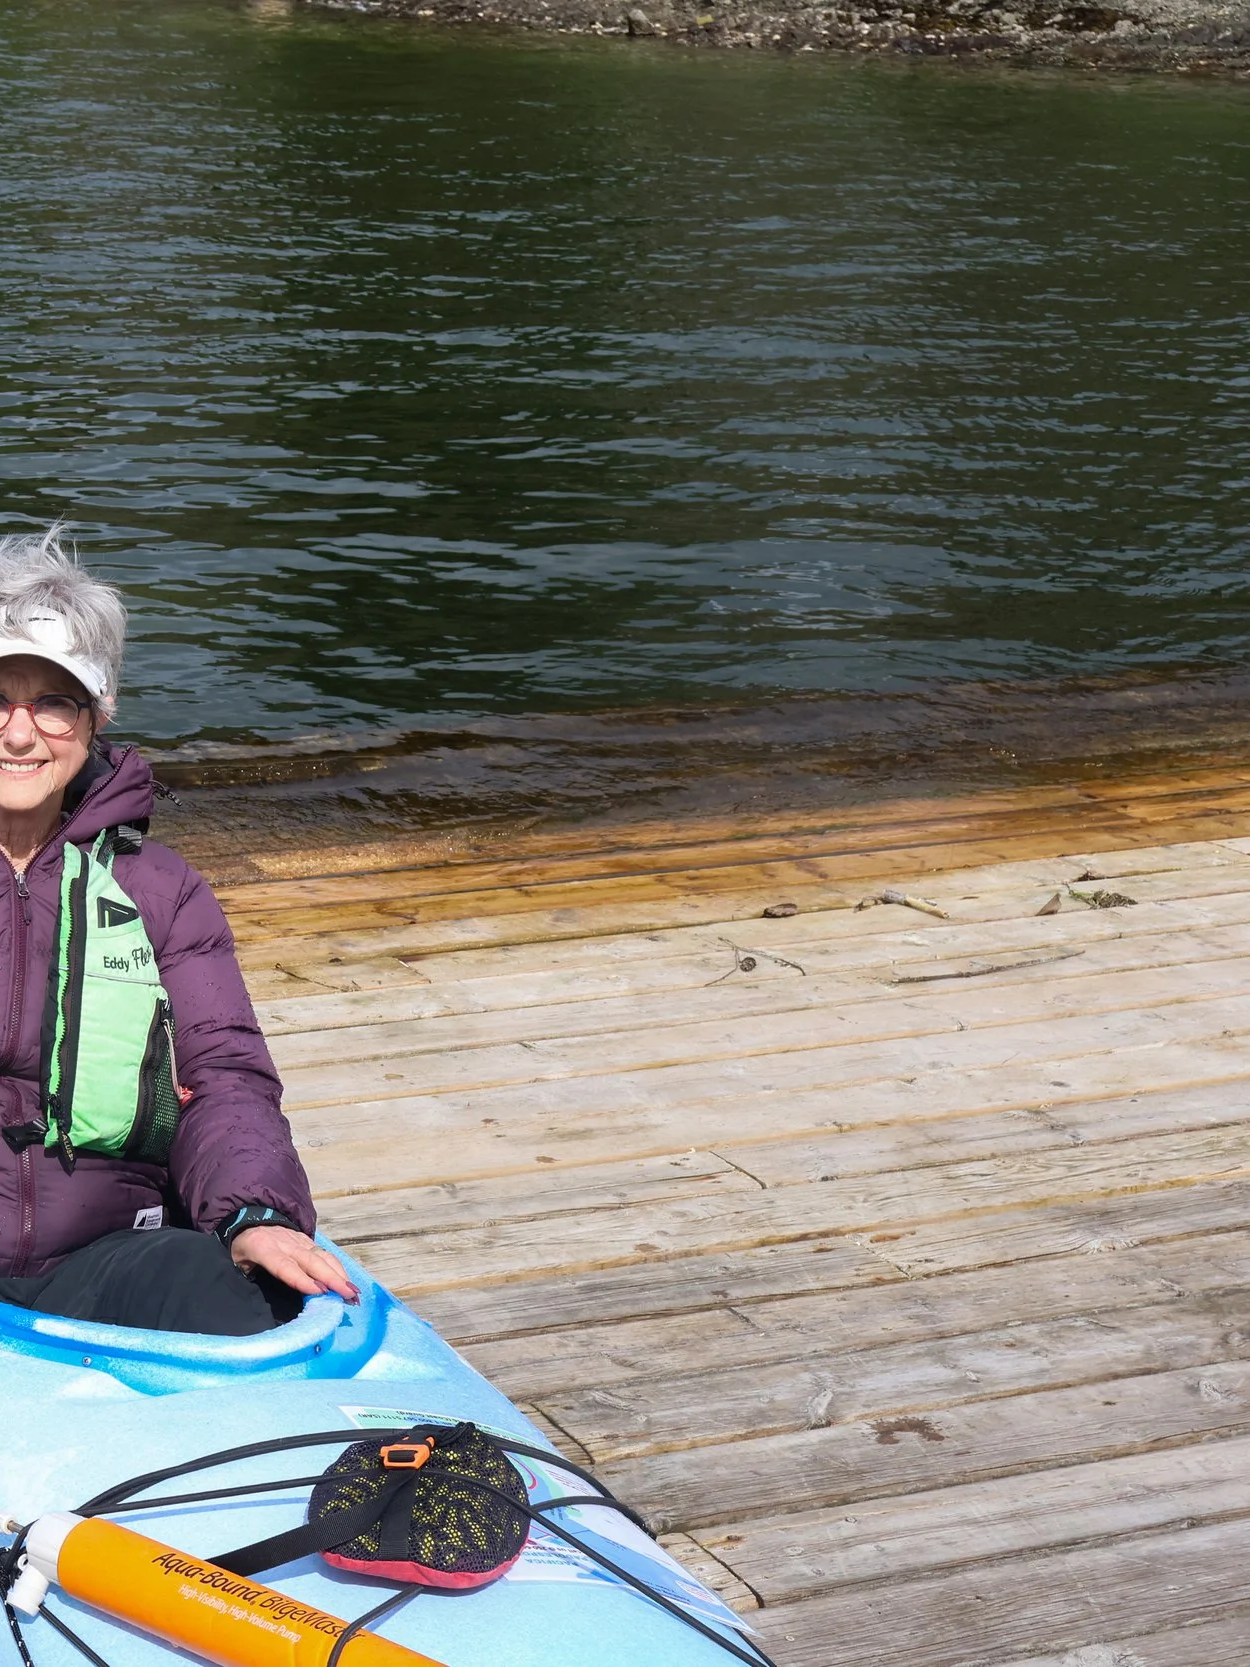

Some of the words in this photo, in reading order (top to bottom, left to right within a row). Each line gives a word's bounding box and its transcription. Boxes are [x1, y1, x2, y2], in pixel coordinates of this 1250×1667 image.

[103, 955, 130, 972] Eddy
[61, 1130, 74, 1156] ALUS
[151, 1552, 269, 1603] Aqua-Bound
[258, 1595, 366, 1641] BilgeMasr
[177, 1583, 229, 1615] High-Visibility,
[228, 1603, 278, 1634] High-Volume
[276, 1624, 302, 1645] Pump
